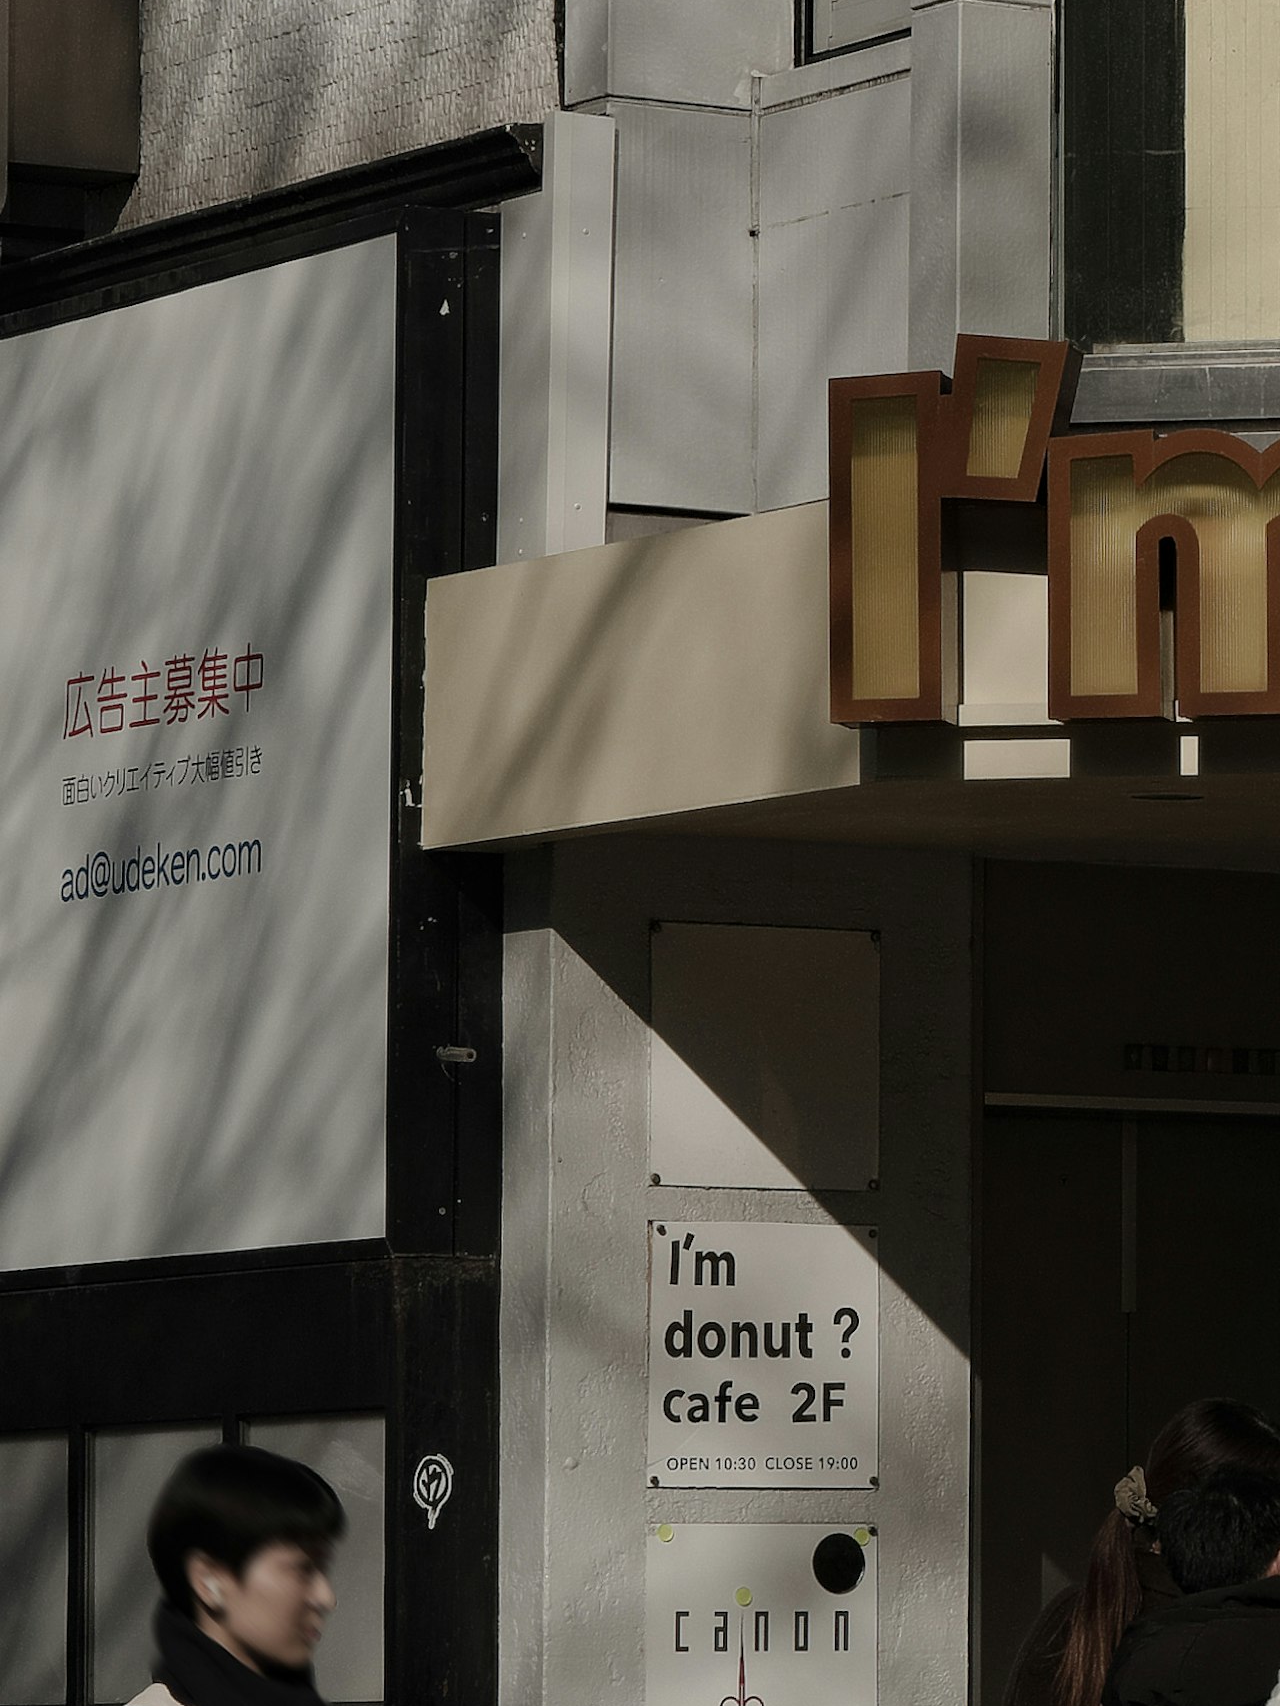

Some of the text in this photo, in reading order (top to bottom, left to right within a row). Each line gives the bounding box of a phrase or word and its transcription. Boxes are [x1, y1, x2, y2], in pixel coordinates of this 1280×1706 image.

[63, 642, 264, 740] 広告主募集中
[61, 745, 263, 807] 面白いクリエイティブ大幅値引き
[60, 839, 262, 902] ad@udeken.com
[669, 1232, 736, 1286] I'm
[664, 1307, 860, 1358] donut ?
[663, 1380, 846, 1423] cafe 2F
[666, 1457, 858, 1470] OPEN 10:30 CLOSE 19:00
[675, 1610, 849, 1652] canon
